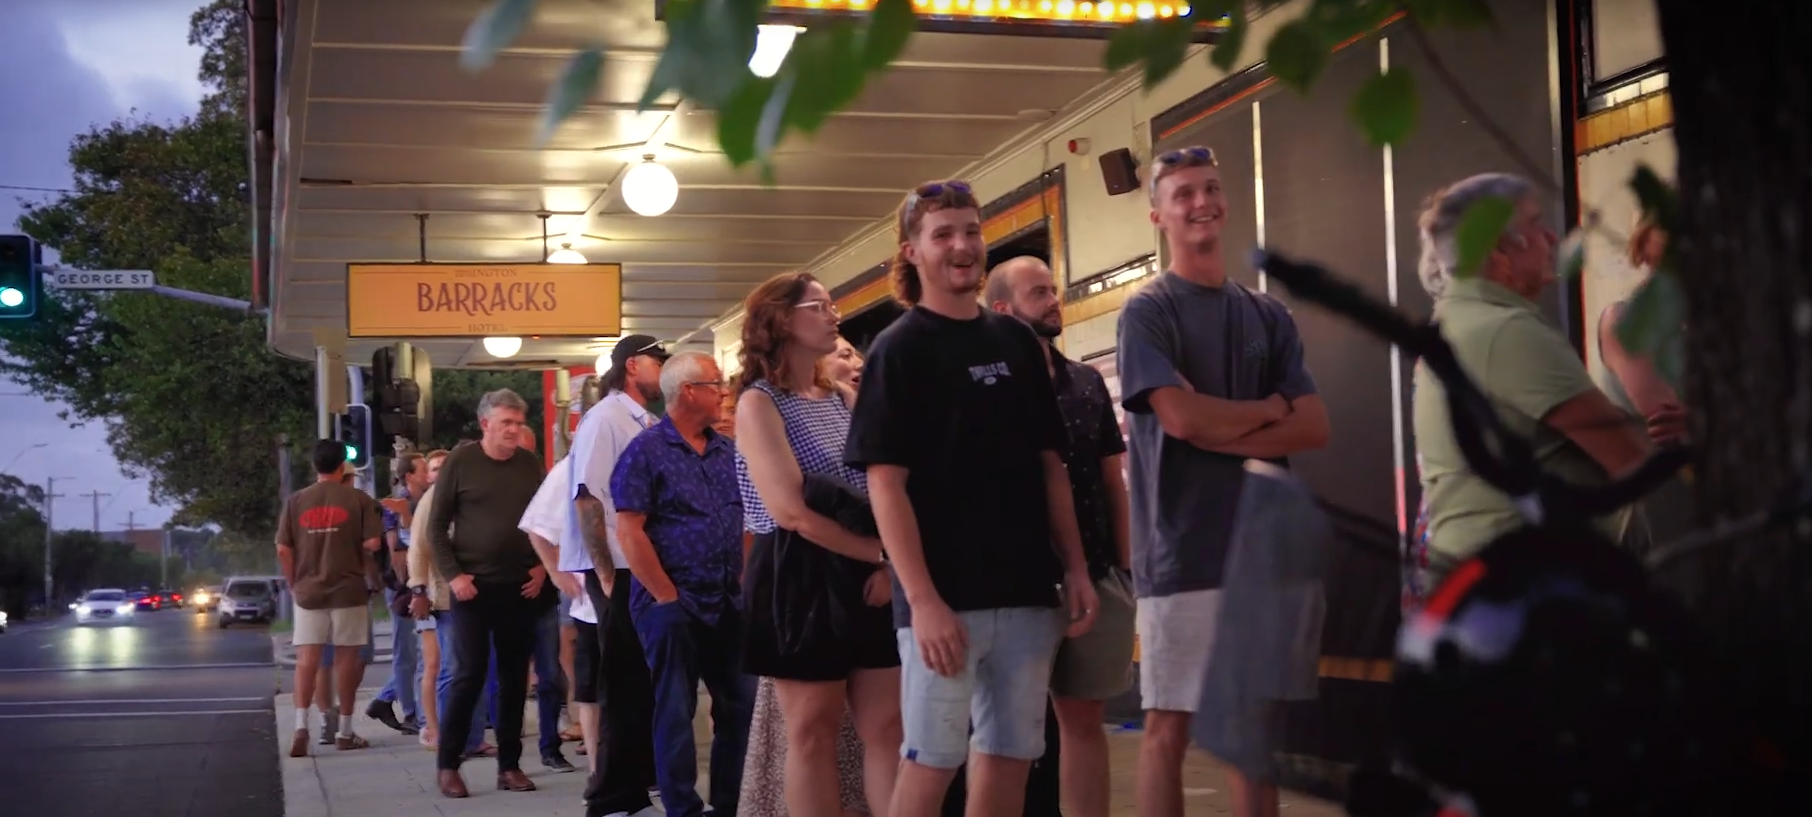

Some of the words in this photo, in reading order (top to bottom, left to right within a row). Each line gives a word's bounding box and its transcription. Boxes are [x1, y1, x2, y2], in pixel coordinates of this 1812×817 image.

[57, 274, 123, 284] GEORGE
[130, 274, 149, 284] ST
[417, 282, 557, 317] BARRACKS
[468, 323, 508, 333] HOTEL
